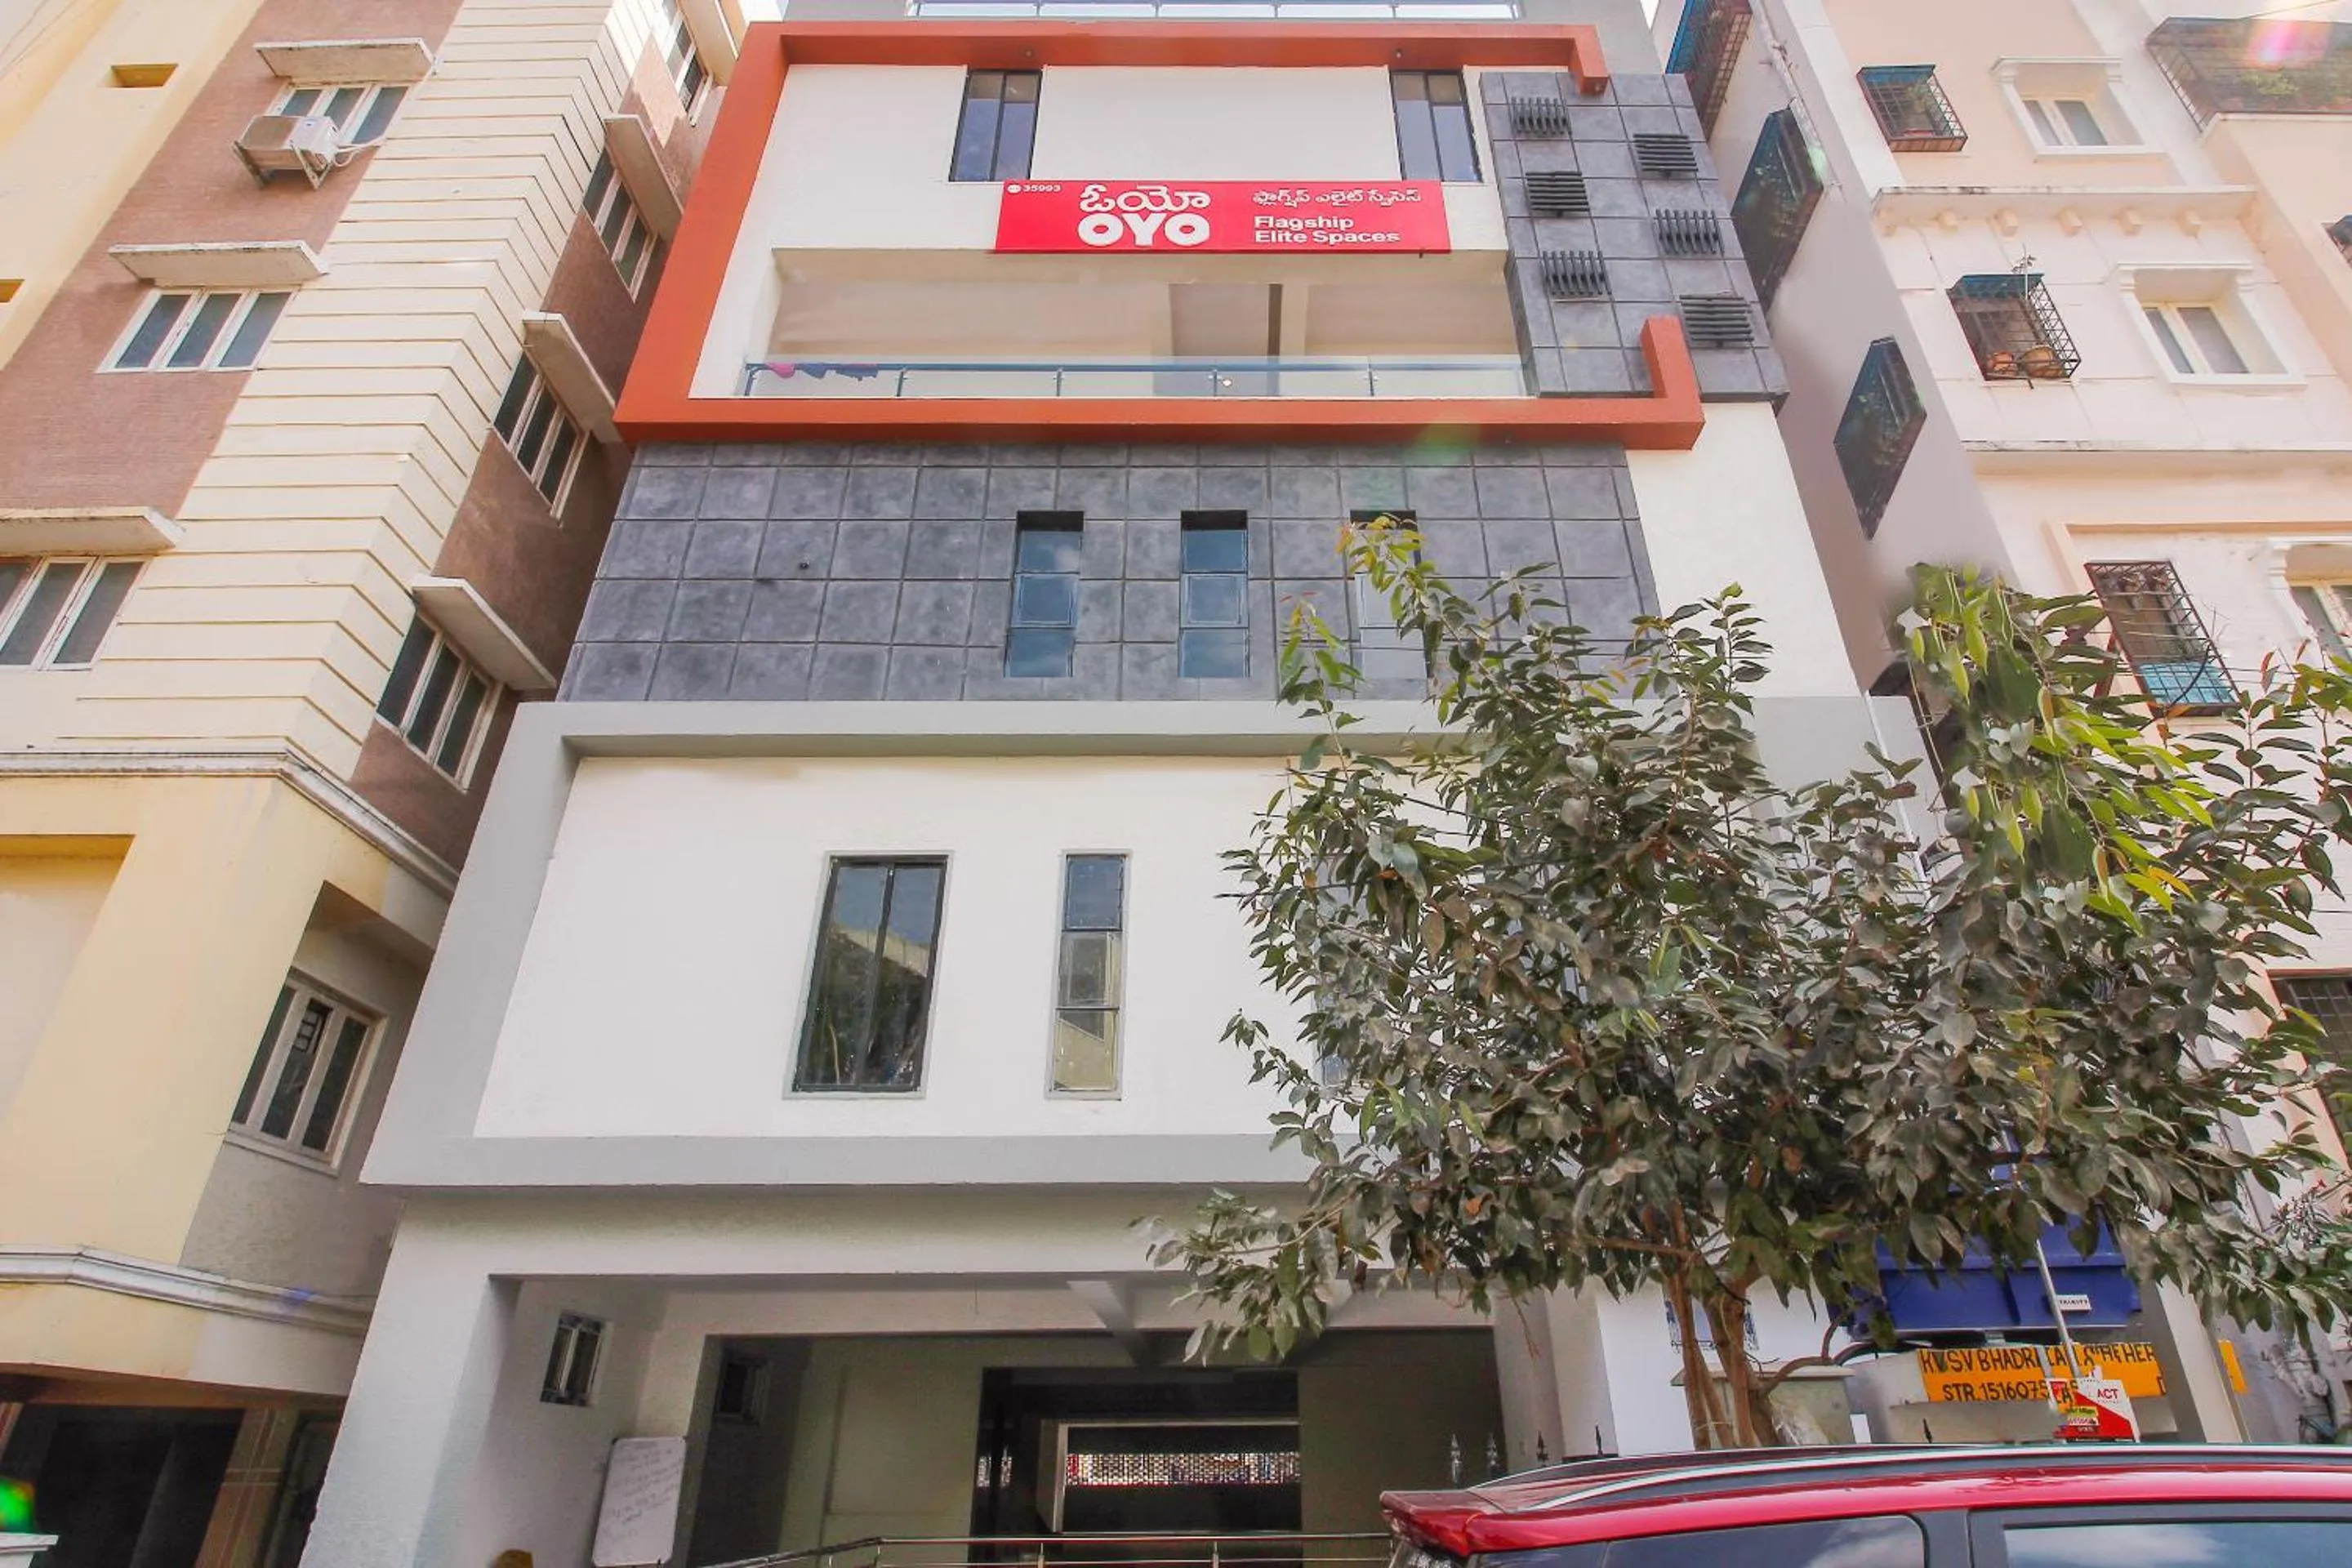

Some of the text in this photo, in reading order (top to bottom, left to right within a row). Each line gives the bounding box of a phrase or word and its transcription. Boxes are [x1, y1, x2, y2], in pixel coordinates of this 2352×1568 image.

[1080, 184, 1211, 212] ఓయో
[1078, 213, 1211, 246] OYO
[1254, 216, 1354, 230] Flagship
[1254, 230, 1401, 245] Elite Spaces
[2097, 1389, 2119, 1400] ACT
